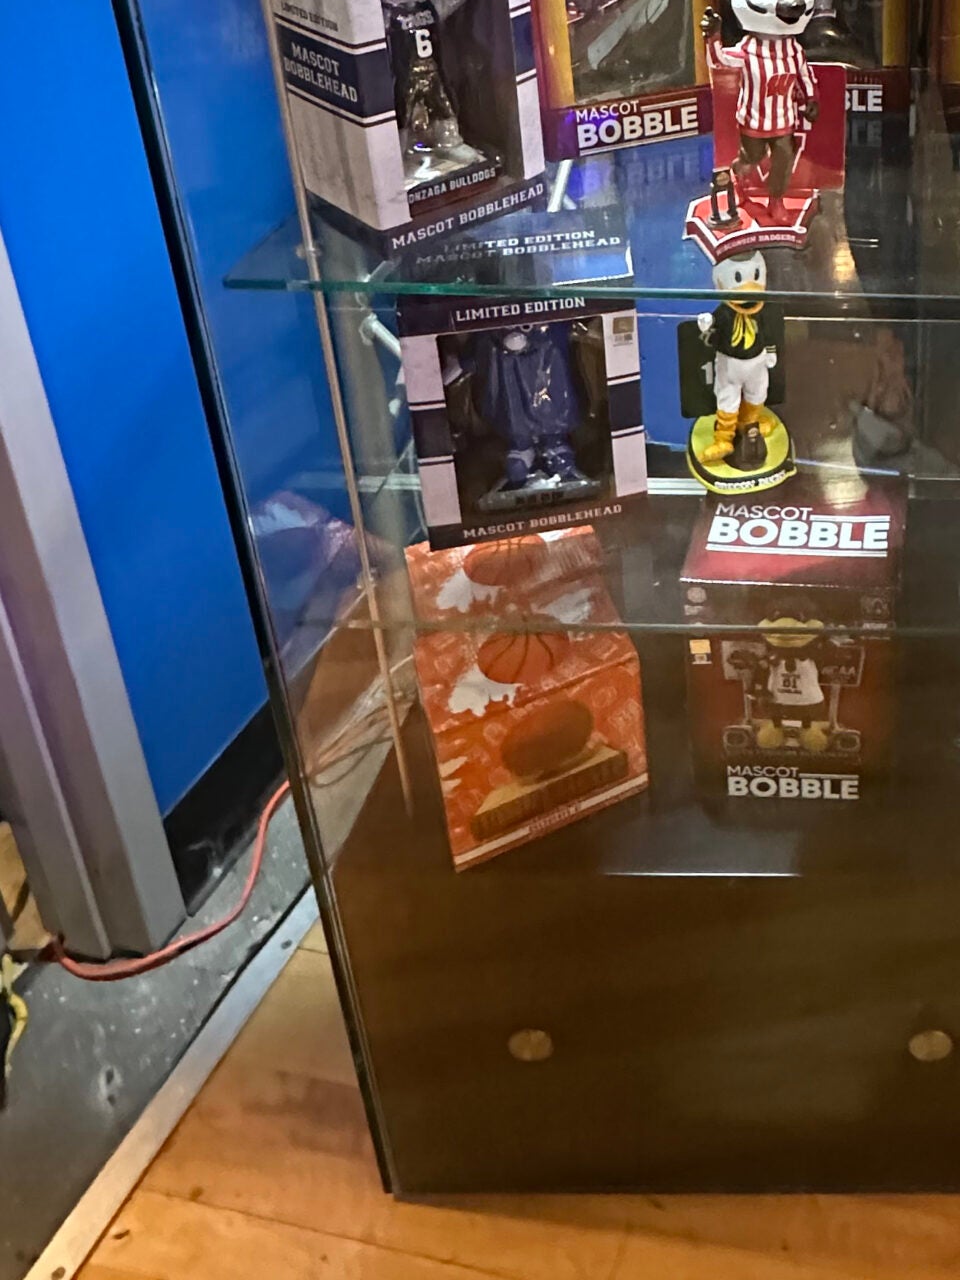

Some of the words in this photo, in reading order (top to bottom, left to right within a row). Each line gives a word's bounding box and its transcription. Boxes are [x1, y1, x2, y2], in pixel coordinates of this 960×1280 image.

[415, 28, 434, 59] 6
[291, 41, 340, 77] MASCOT
[283, 55, 358, 103] BOBBLEHEAD
[575, 99, 640, 123] MASCOT
[576, 104, 699, 149] BOBBLE
[408, 180, 447, 205] ONZAGA
[448, 166, 497, 191] BULLDOGS
[391, 217, 455, 250] MASCOT
[459, 182, 545, 226] BOBBLEHEAD
[502, 236, 621, 257] BOBBLEHEAD
[524, 229, 596, 245] EDITION
[758, 233, 796, 242] BADGERS
[455, 303, 521, 322] LIMITED
[524, 296, 586, 314] EDITION
[714, 479, 756, 490] OREGON
[463, 521, 526, 540] MASCOT
[529, 503, 622, 529] BOBBLEHEAD
[715, 502, 813, 520] MASCOT
[707, 515, 890, 550] BOBBLE
[727, 765, 800, 778] MASCOT
[727, 776, 860, 800] BOBBLE
